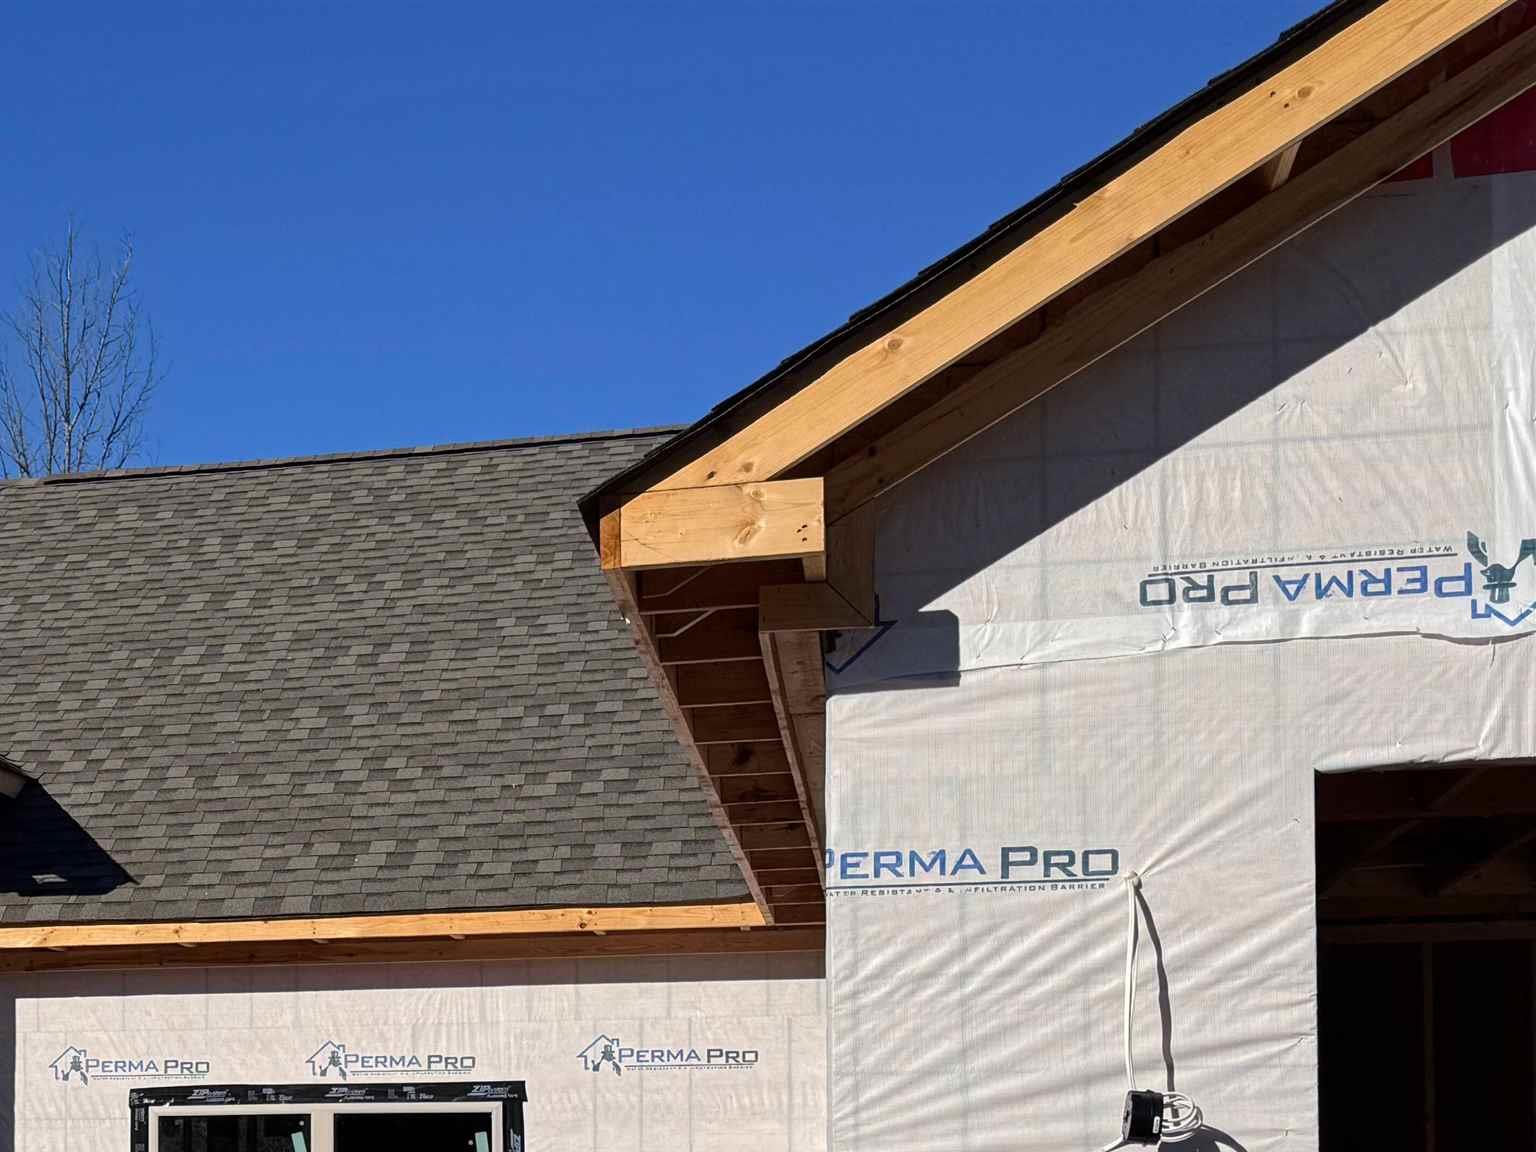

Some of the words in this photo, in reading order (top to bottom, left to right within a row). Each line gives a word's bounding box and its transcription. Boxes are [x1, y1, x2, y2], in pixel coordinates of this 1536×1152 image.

[1139, 571, 1260, 607] PRO
[1272, 561, 1472, 601] PERMA
[1000, 845, 1120, 880] PRO
[961, 884, 1046, 894] FILTRATION
[344, 1053, 422, 1069] PERMA
[427, 1054, 476, 1070] PRO
[618, 1047, 702, 1063] PERMA
[707, 1048, 759, 1063] PRO
[85, 1058, 159, 1074] PERMA
[164, 1059, 210, 1075] PRO
